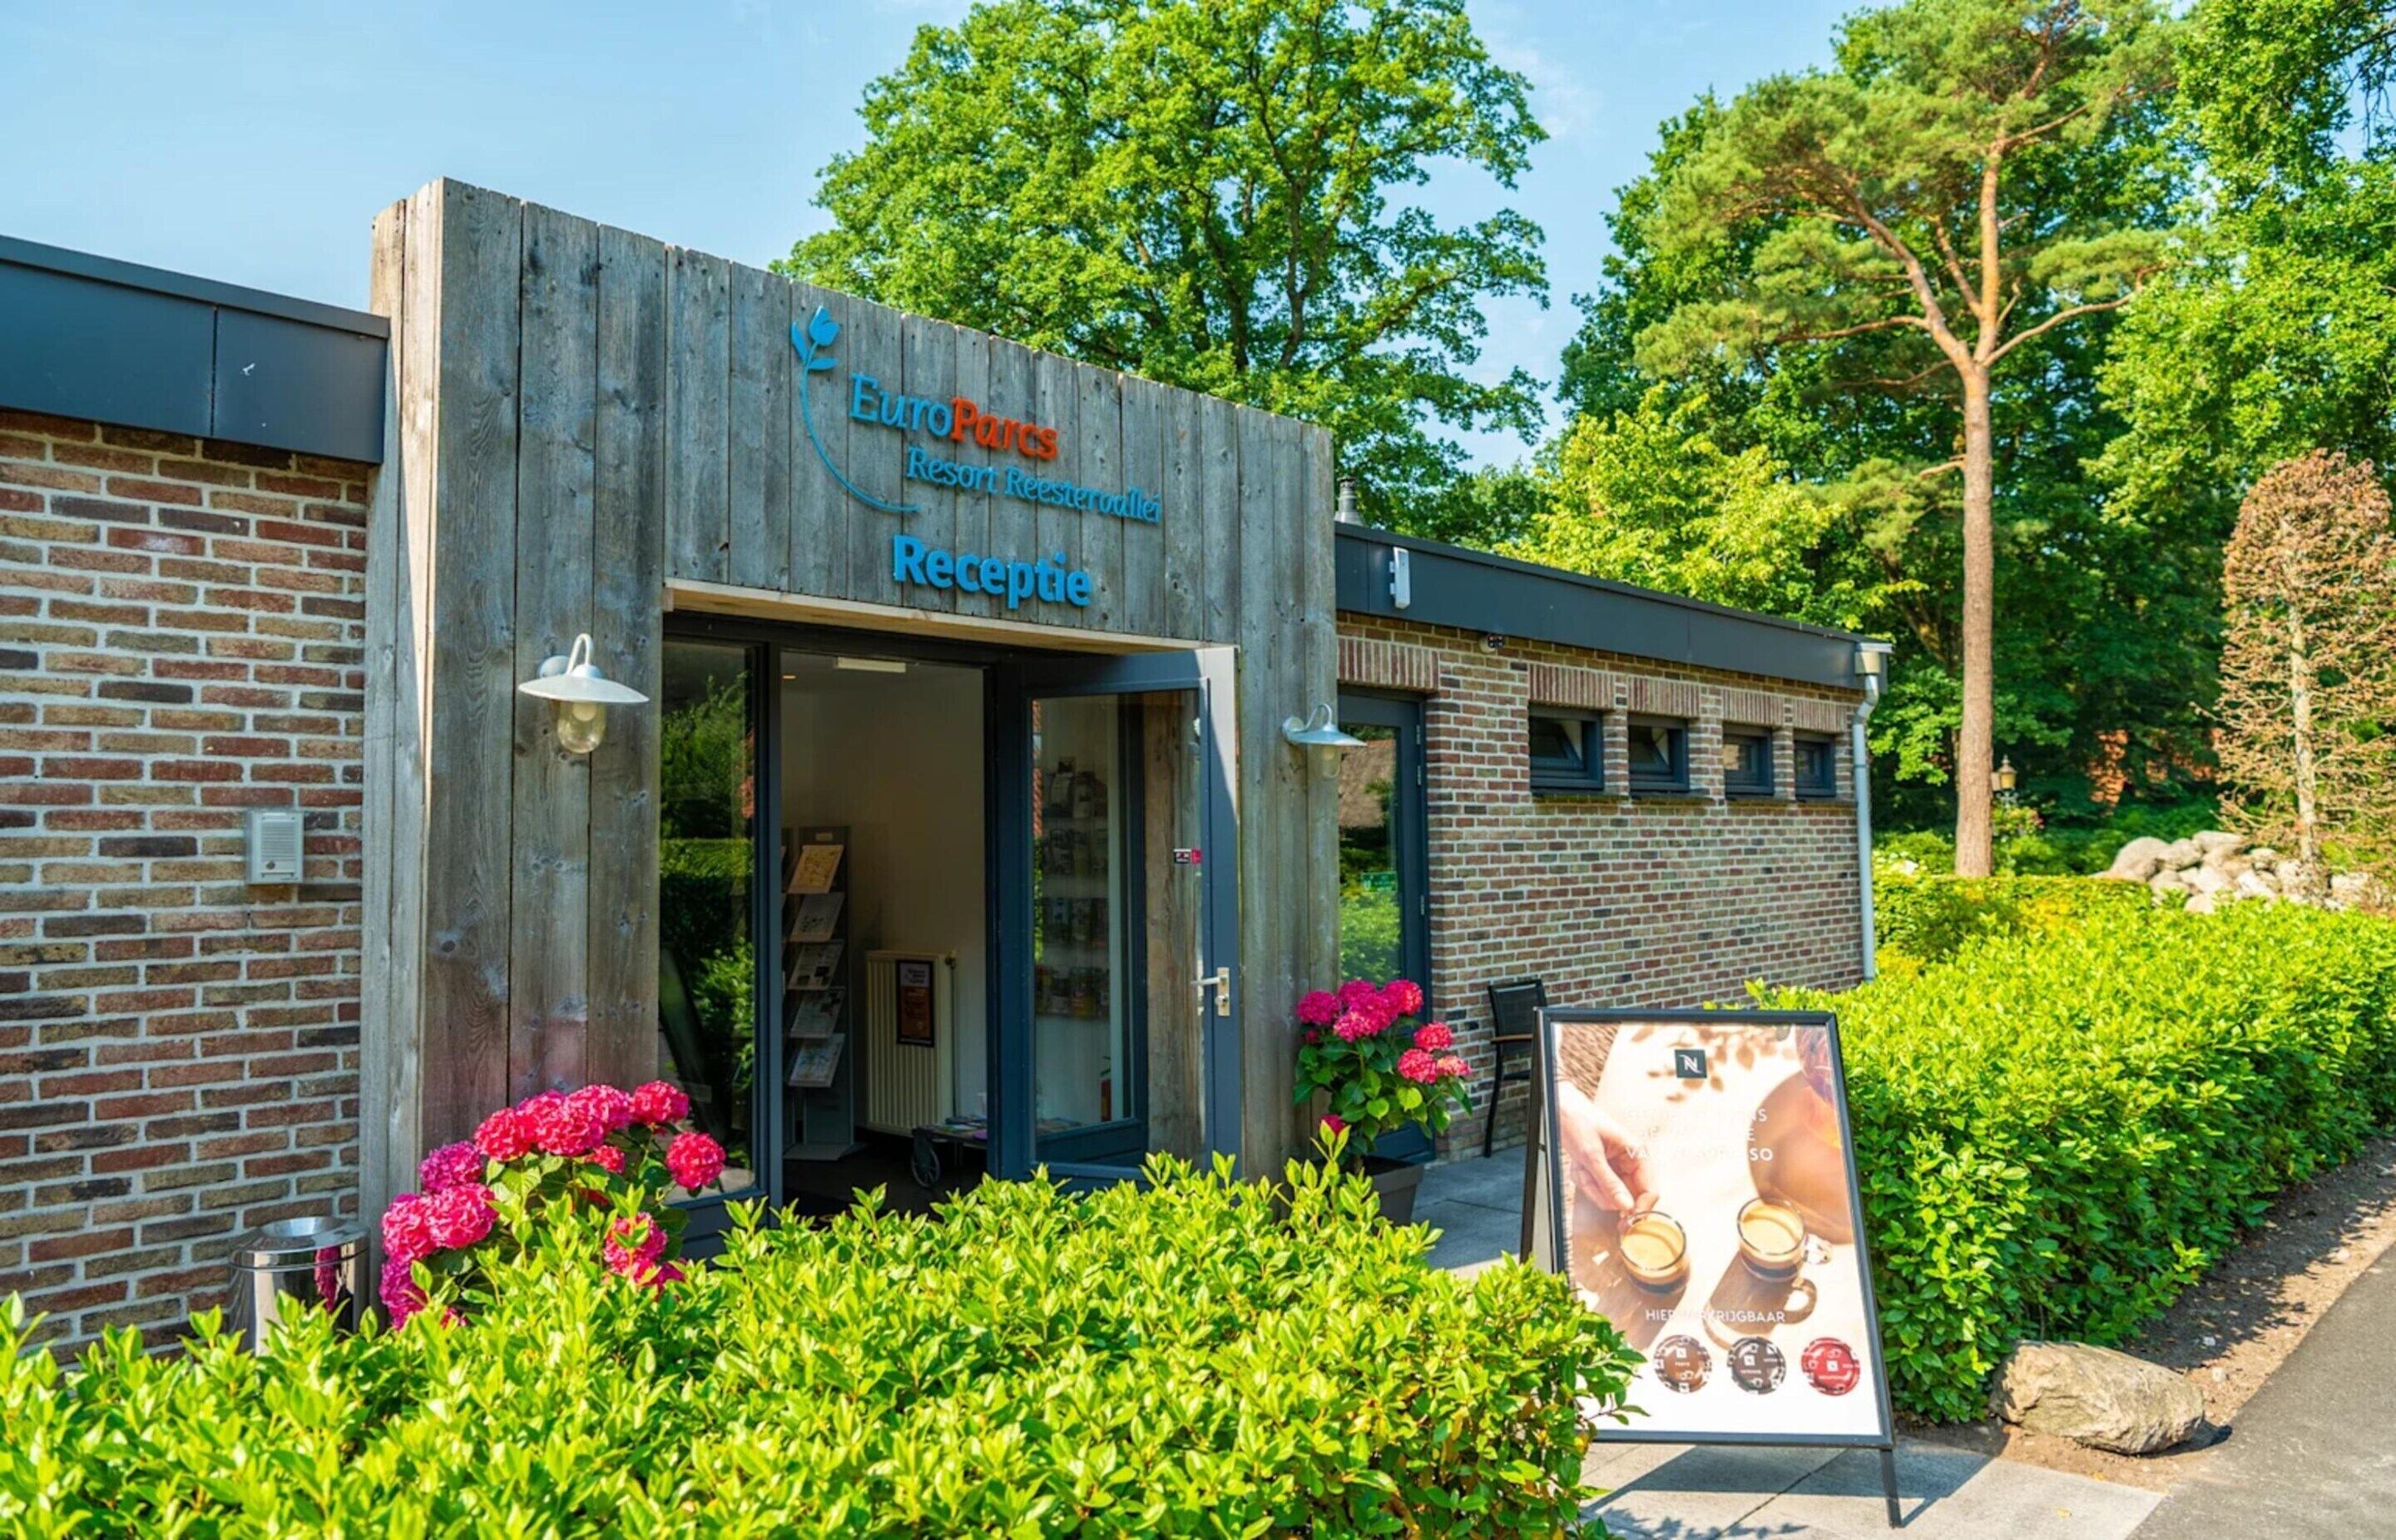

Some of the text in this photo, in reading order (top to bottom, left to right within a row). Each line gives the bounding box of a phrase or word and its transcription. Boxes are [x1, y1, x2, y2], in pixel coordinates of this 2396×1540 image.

[849, 373, 1058, 460] EuroParcs
[906, 445, 1161, 525] Resort Reestervallei
[893, 535, 1092, 610] Receptie
